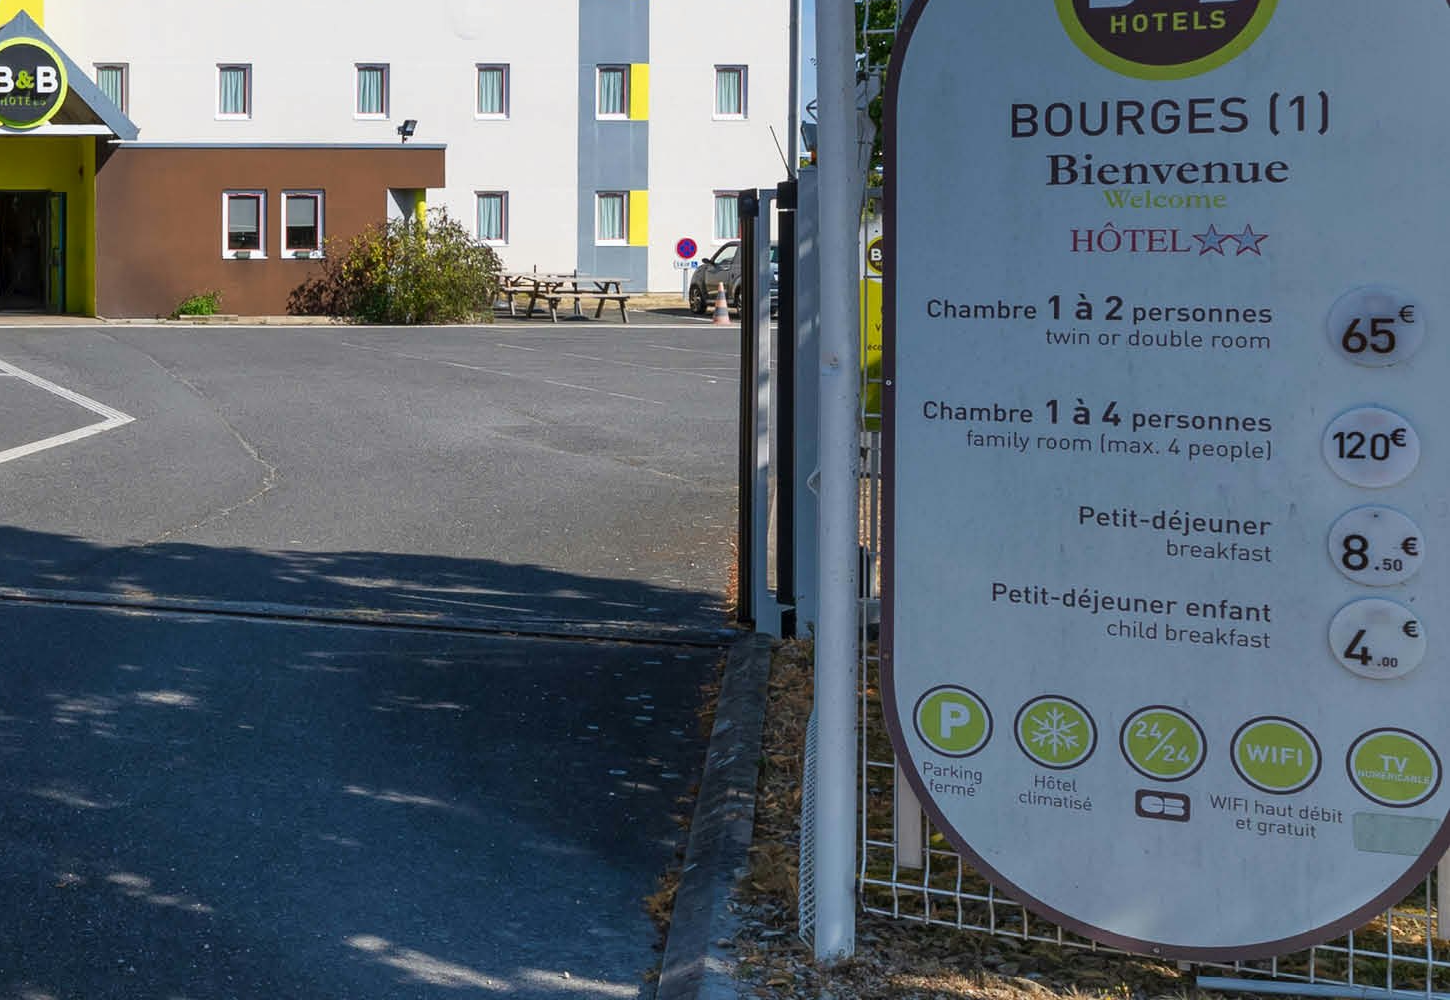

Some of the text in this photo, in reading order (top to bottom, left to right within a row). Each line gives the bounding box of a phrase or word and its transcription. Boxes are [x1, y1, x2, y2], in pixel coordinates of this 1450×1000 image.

[1110, 9, 1227, 34] HOTELS
[0, 96, 47, 106] HOTELS
[1011, 90, 1329, 138] BOURGES (1)
[1045, 153, 1289, 186] Bienvenue
[1102, 188, 1227, 210] Welcome
[1070, 222, 1191, 253] HÔTEL
[927, 293, 1273, 326] Chambre 1 à 2 personnes
[1045, 328, 1271, 349] twin or double room
[923, 398, 1272, 433] Chambre 1 à 4 personnes
[966, 430, 1272, 462] family room (max. 4 people)
[1079, 505, 1272, 537] Petit-déjeuner
[1166, 539, 1272, 563] breakfast
[992, 582, 1271, 623] Petit-déjeuner enfant
[1106, 620, 1271, 649] child breakfast
[940, 702, 971, 739] P
[1246, 743, 1303, 767] WIFI
[1378, 754, 1408, 776] TV
[923, 762, 983, 784] Parking
[1034, 775, 1077, 793] Hôtel
[929, 778, 976, 797] fermé
[1019, 791, 1093, 811] climatisé
[1208, 793, 1343, 824] WIFI haut débit
[1236, 818, 1317, 840] et gratuit
